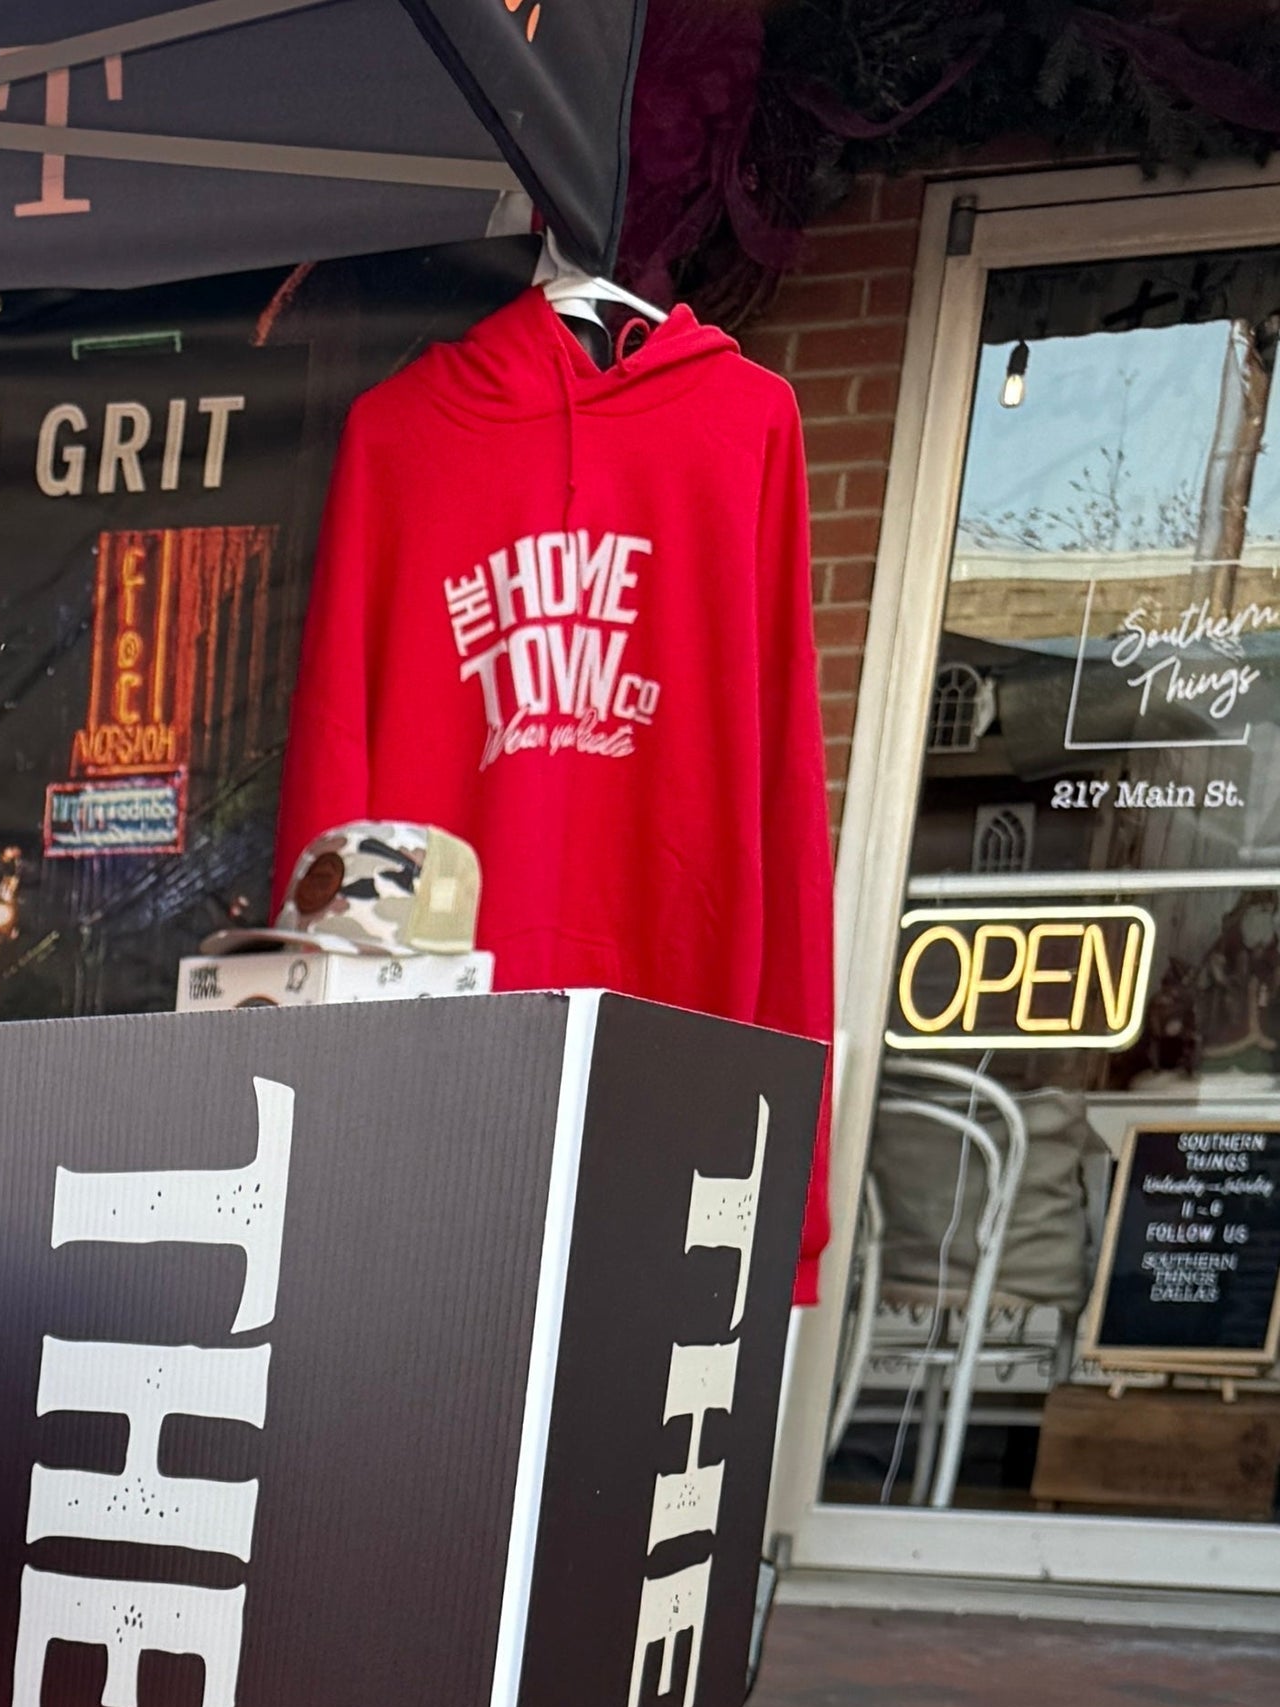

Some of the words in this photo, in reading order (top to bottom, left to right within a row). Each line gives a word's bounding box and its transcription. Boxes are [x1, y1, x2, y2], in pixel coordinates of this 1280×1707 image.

[37, 396, 244, 497] GRIT
[444, 564, 496, 657] THE
[488, 528, 653, 632] HOME
[1112, 597, 1279, 668] Southern
[612, 672, 661, 725] CO
[1127, 654, 1260, 719] Things
[1051, 781, 1107, 809] 217
[1114, 780, 1195, 809] Main
[1204, 780, 1244, 808] St.
[899, 924, 1140, 1032] OPEN
[1177, 1132, 1267, 1152] SOUTHERN
[1185, 1152, 1250, 1172] THINGS
[1146, 1222, 1216, 1243] FOLLOW
